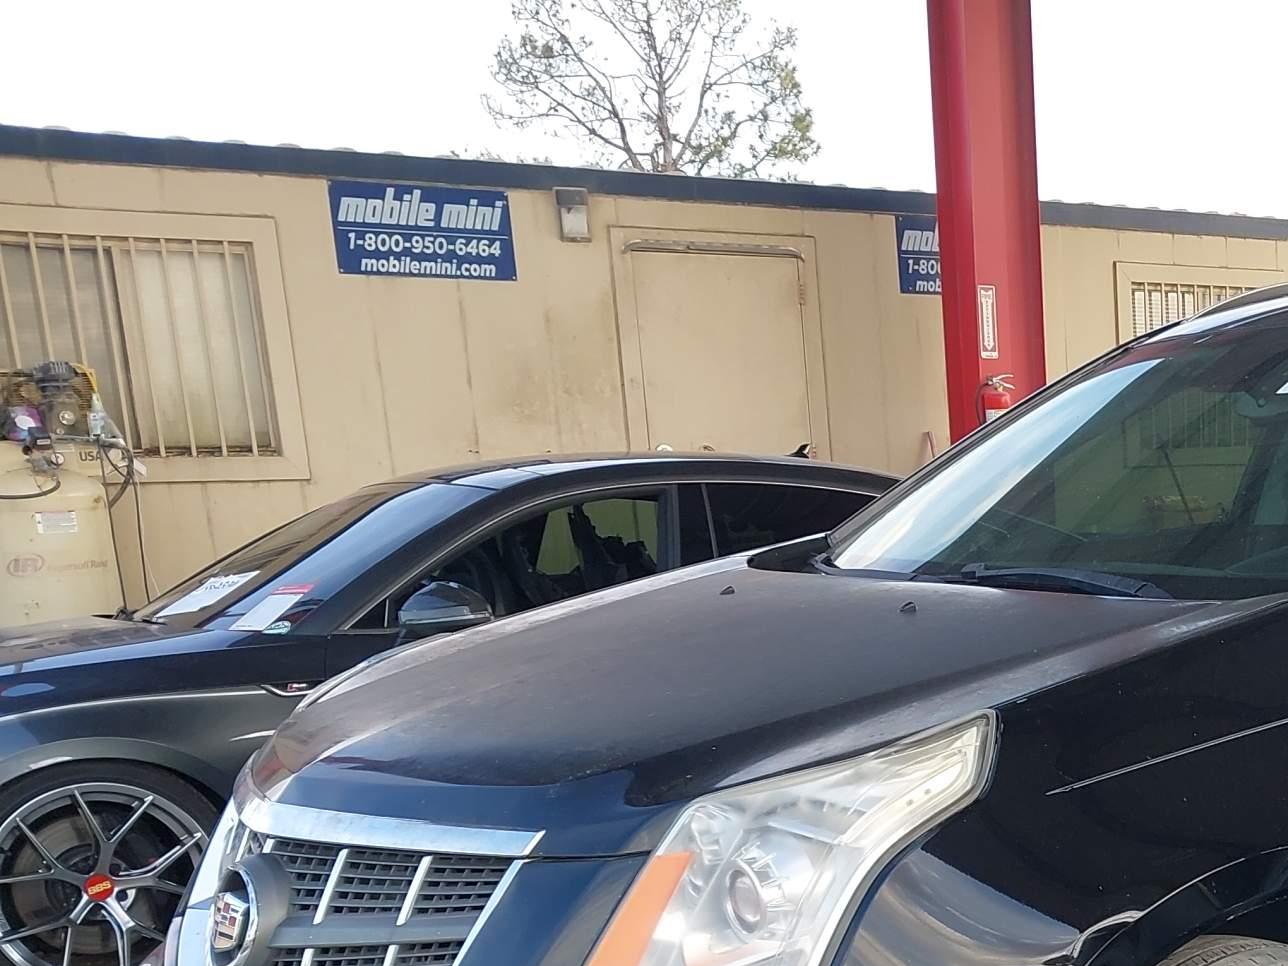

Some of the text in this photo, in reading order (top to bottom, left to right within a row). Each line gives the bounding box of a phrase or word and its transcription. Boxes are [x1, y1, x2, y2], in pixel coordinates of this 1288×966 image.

[337, 187, 503, 231] mobile mini
[347, 232, 501, 257] 1-800-950-6464
[360, 256, 496, 277] mobilemini.com
[79, 451, 102, 462] USA
[88, 881, 112, 895] BBS
